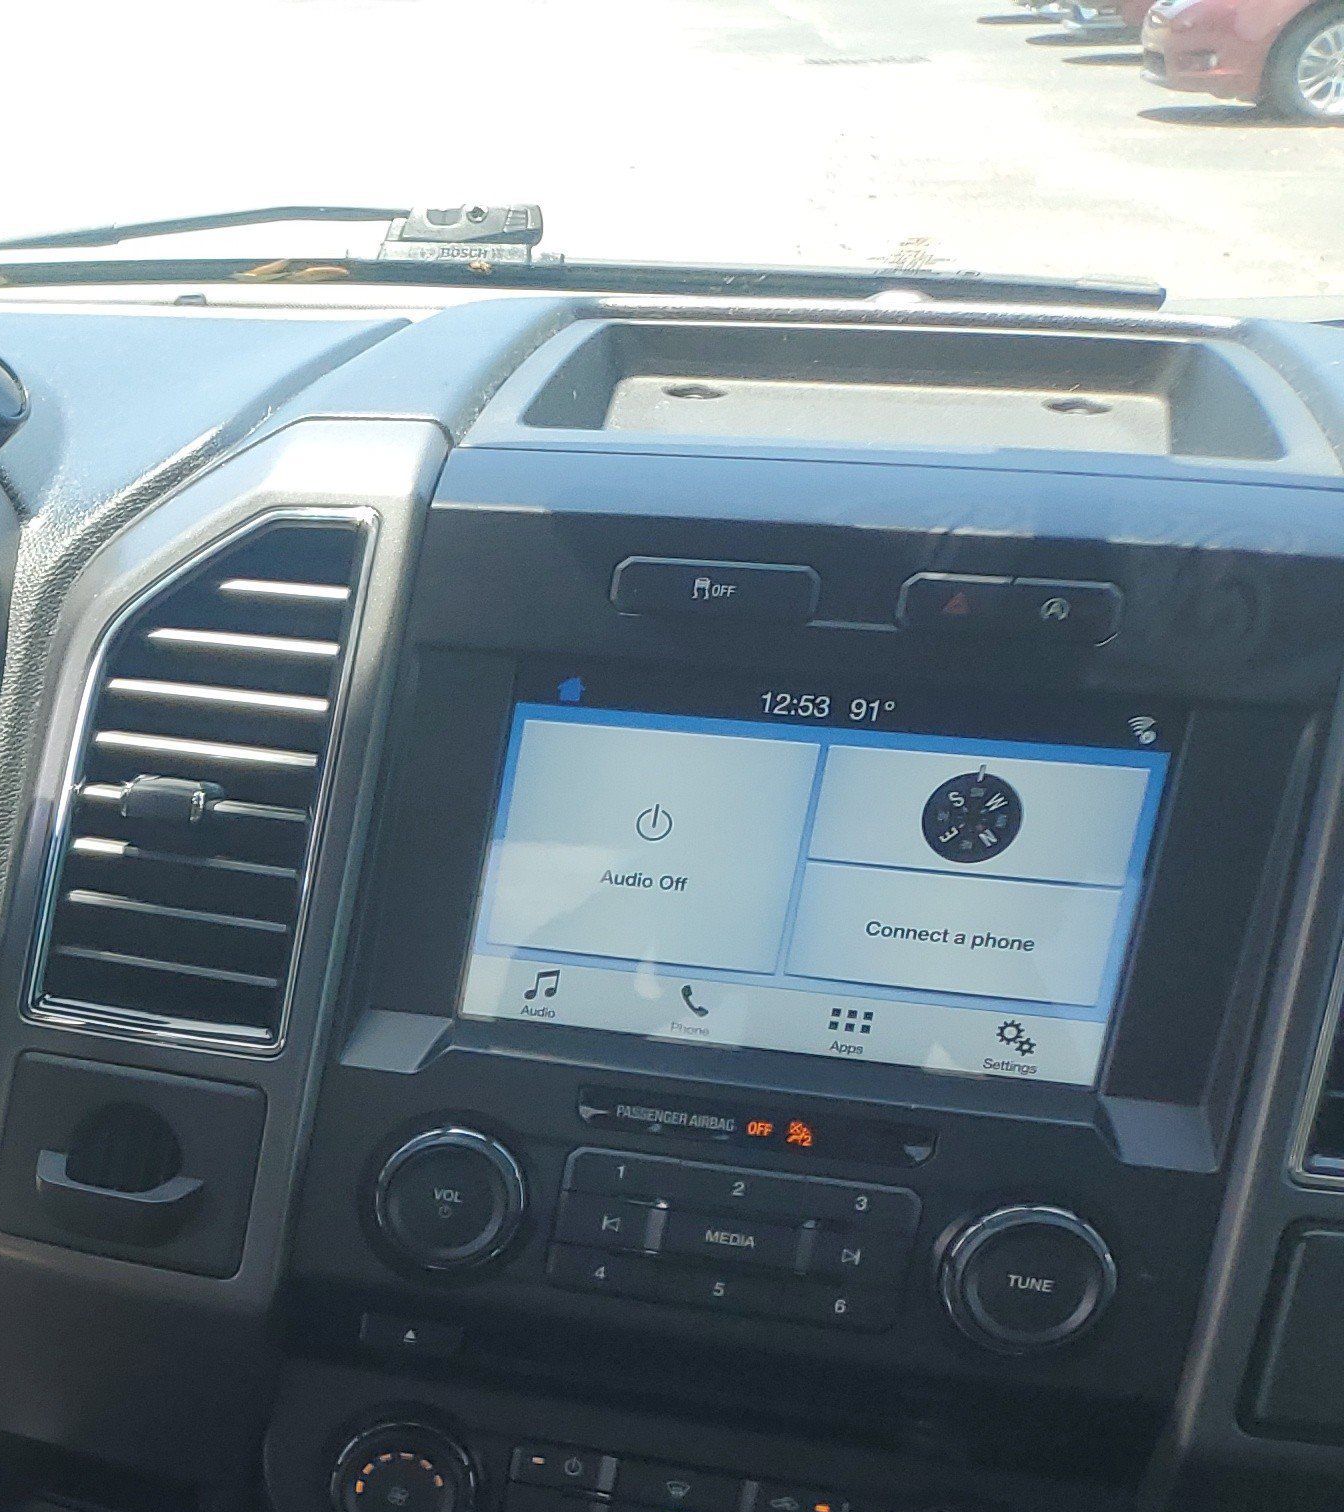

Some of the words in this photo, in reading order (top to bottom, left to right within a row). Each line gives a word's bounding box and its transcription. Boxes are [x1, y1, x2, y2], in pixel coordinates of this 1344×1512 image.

[441, 247, 488, 259] BOSCH
[712, 584, 737, 597] OFF
[761, 691, 831, 718] 12:53
[948, 791, 965, 807] S
[984, 792, 1009, 812] W
[938, 827, 959, 843] E
[600, 869, 654, 889] Audio
[658, 874, 689, 892] Off
[865, 920, 949, 944] Connect
[953, 931, 966, 946] a
[971, 931, 1035, 952] phone
[520, 1004, 556, 1019] Audio
[670, 1021, 710, 1036] Phone
[829, 1040, 864, 1055] Apps
[982, 1057, 1037, 1075] Settings
[616, 1104, 688, 1126] PASSENGER
[689, 1112, 735, 1132] AIRBAG
[747, 1120, 774, 1137] OFF
[617, 1165, 626, 1179] 1
[434, 1188, 462, 1203] VOL
[732, 1181, 745, 1196] 2
[855, 1196, 868, 1211] 3
[705, 1229, 756, 1248] MEDIA
[594, 1265, 605, 1279] 4
[713, 1282, 726, 1297] 5
[1007, 1274, 1055, 1293] TUNE
[834, 1299, 846, 1314] 6
